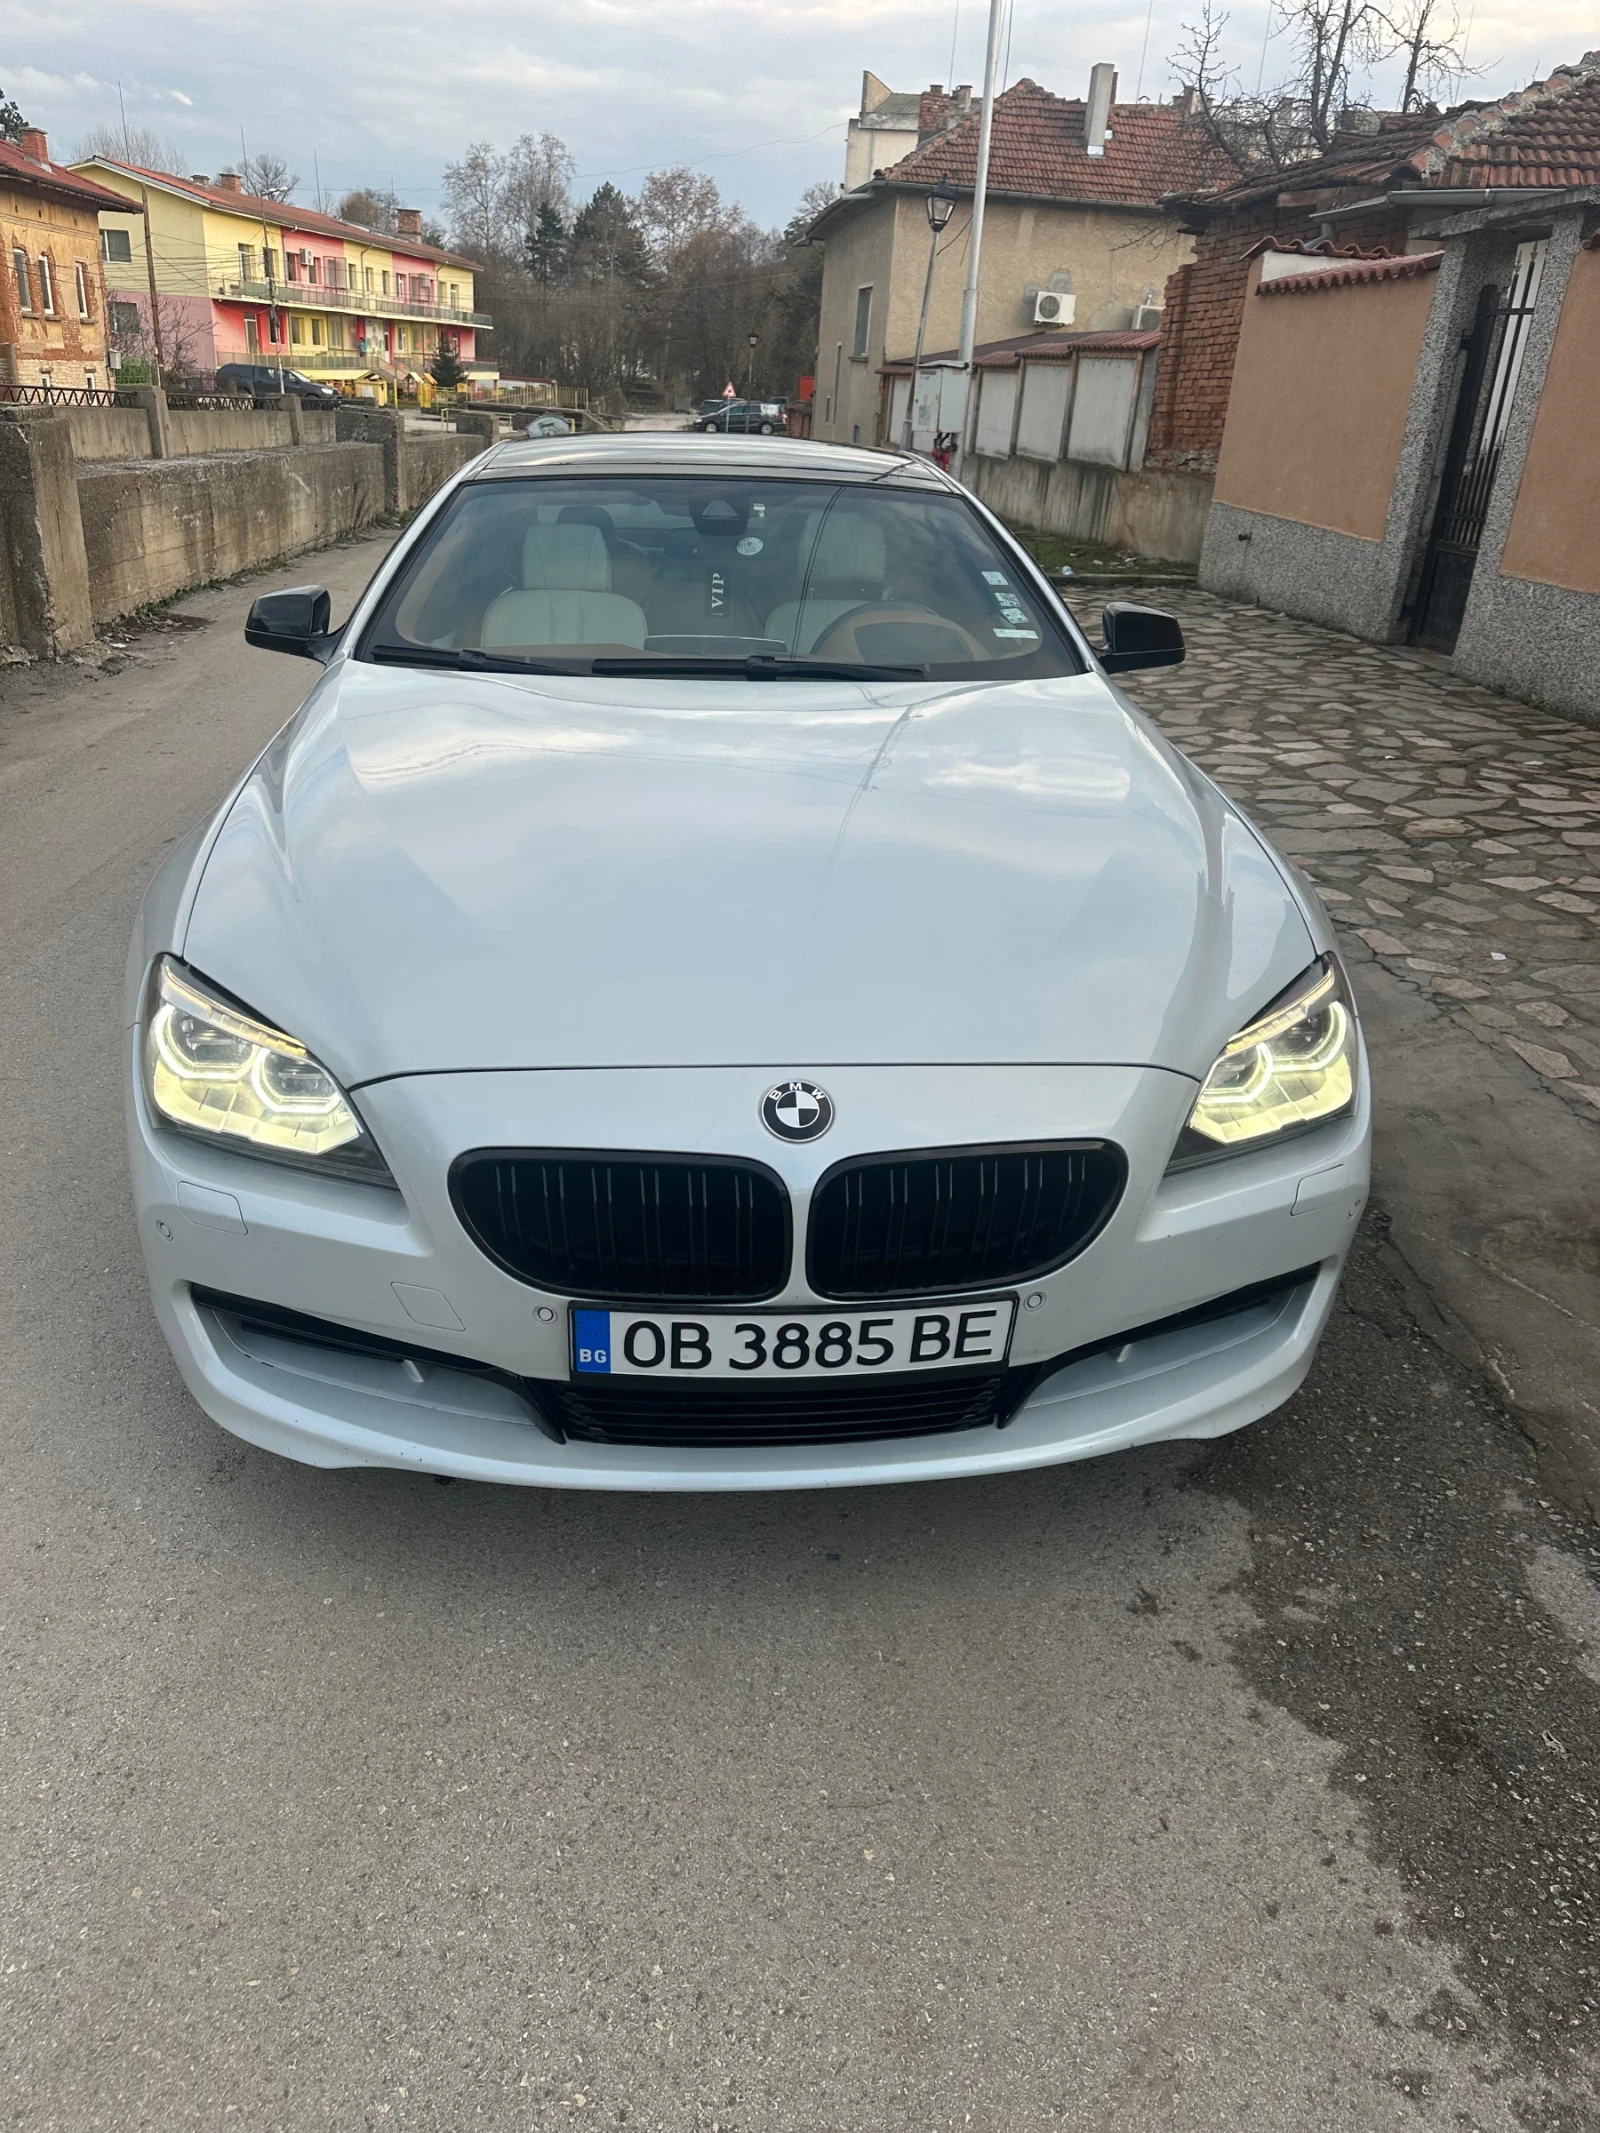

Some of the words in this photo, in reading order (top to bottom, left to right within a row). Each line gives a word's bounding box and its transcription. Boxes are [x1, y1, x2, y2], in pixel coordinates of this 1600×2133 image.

[712, 573, 724, 608] VIP
[769, 1083, 825, 1100] BMW
[624, 1321, 711, 1369] OB
[729, 1318, 894, 1370] 3885
[909, 1310, 997, 1362] BE
[579, 1349, 607, 1364] BG
